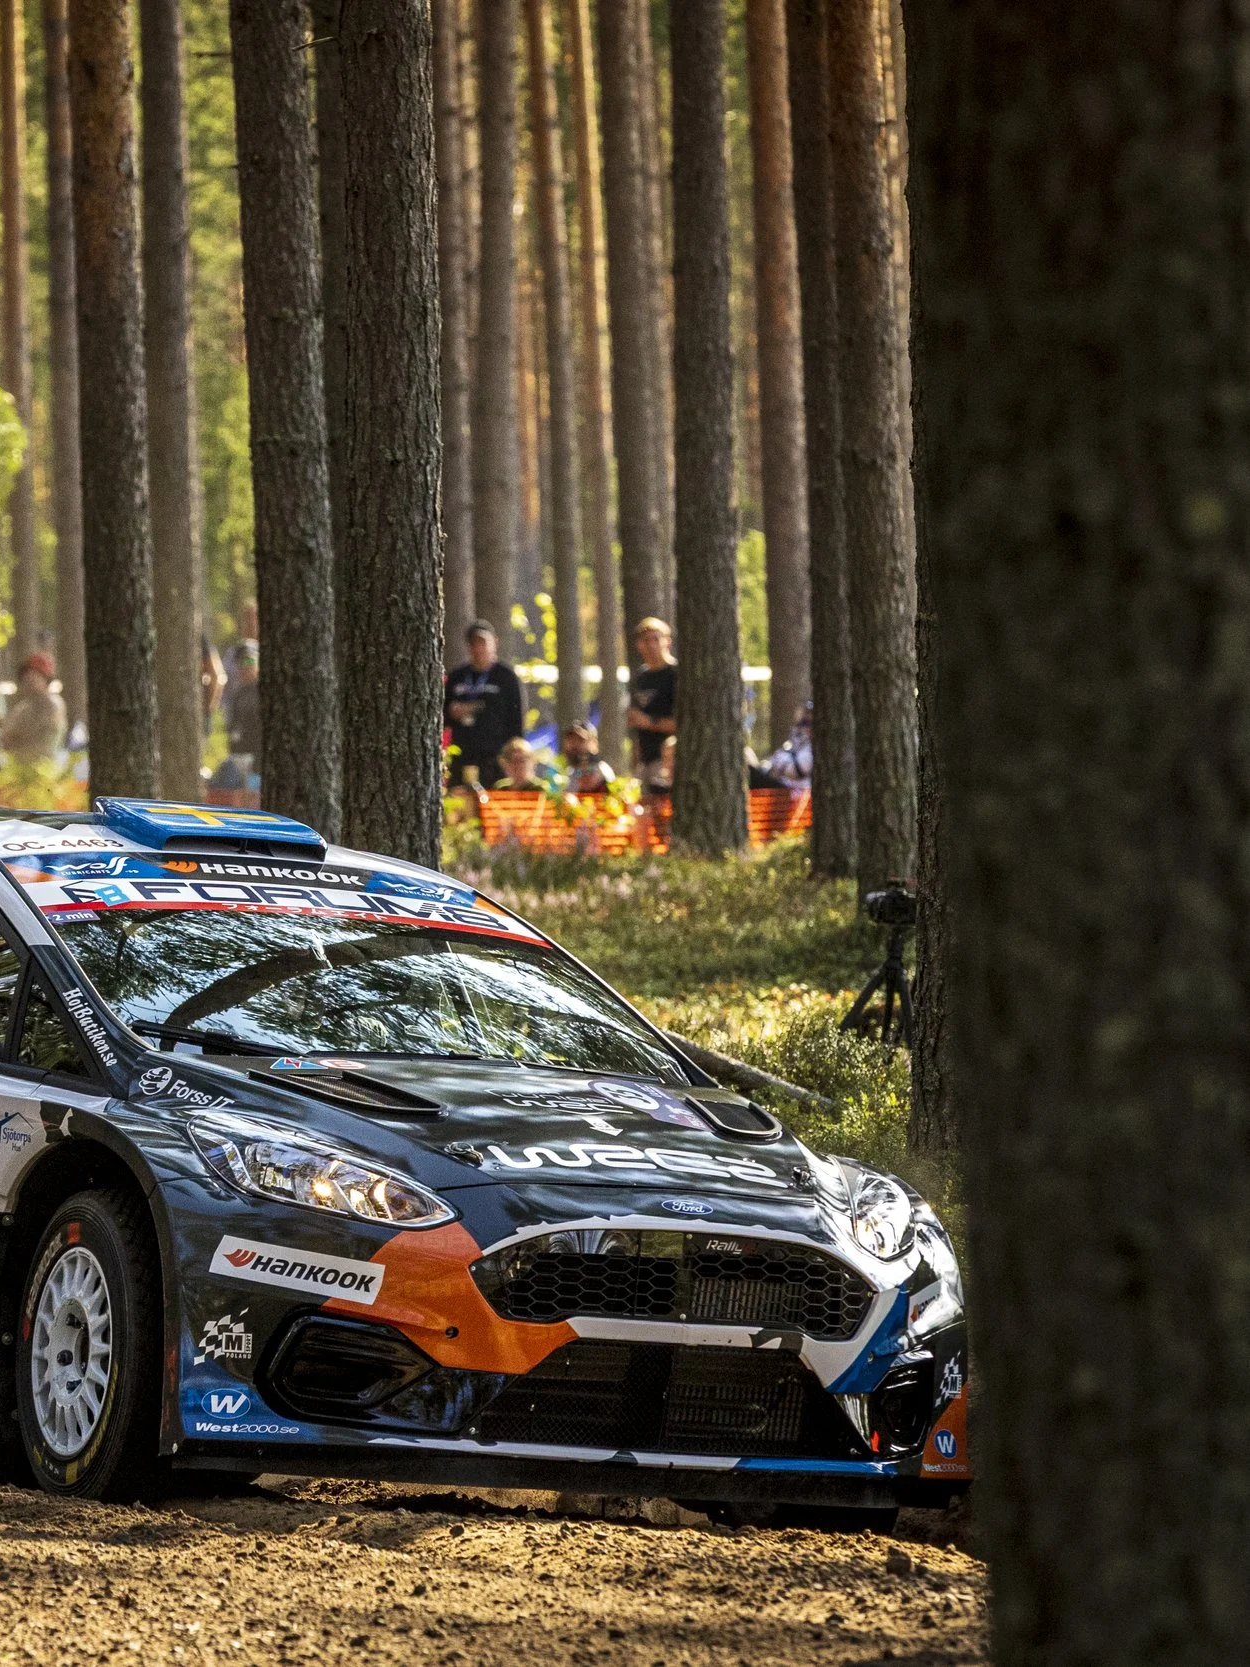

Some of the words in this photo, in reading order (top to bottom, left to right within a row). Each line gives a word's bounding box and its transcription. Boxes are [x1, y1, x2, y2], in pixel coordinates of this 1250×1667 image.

[2, 839, 124, 852] OC-4463
[130, 881, 509, 931] FORUM8
[65, 912, 94, 920] min
[167, 1079, 212, 1105] Forss
[208, 1095, 235, 1110] IT
[2, 1127, 32, 1148] Sjötorps
[486, 1143, 789, 1189] WRC2
[671, 1200, 706, 1213] Ford
[224, 1334, 244, 1352] M
[195, 1422, 300, 1434] West2000.se
